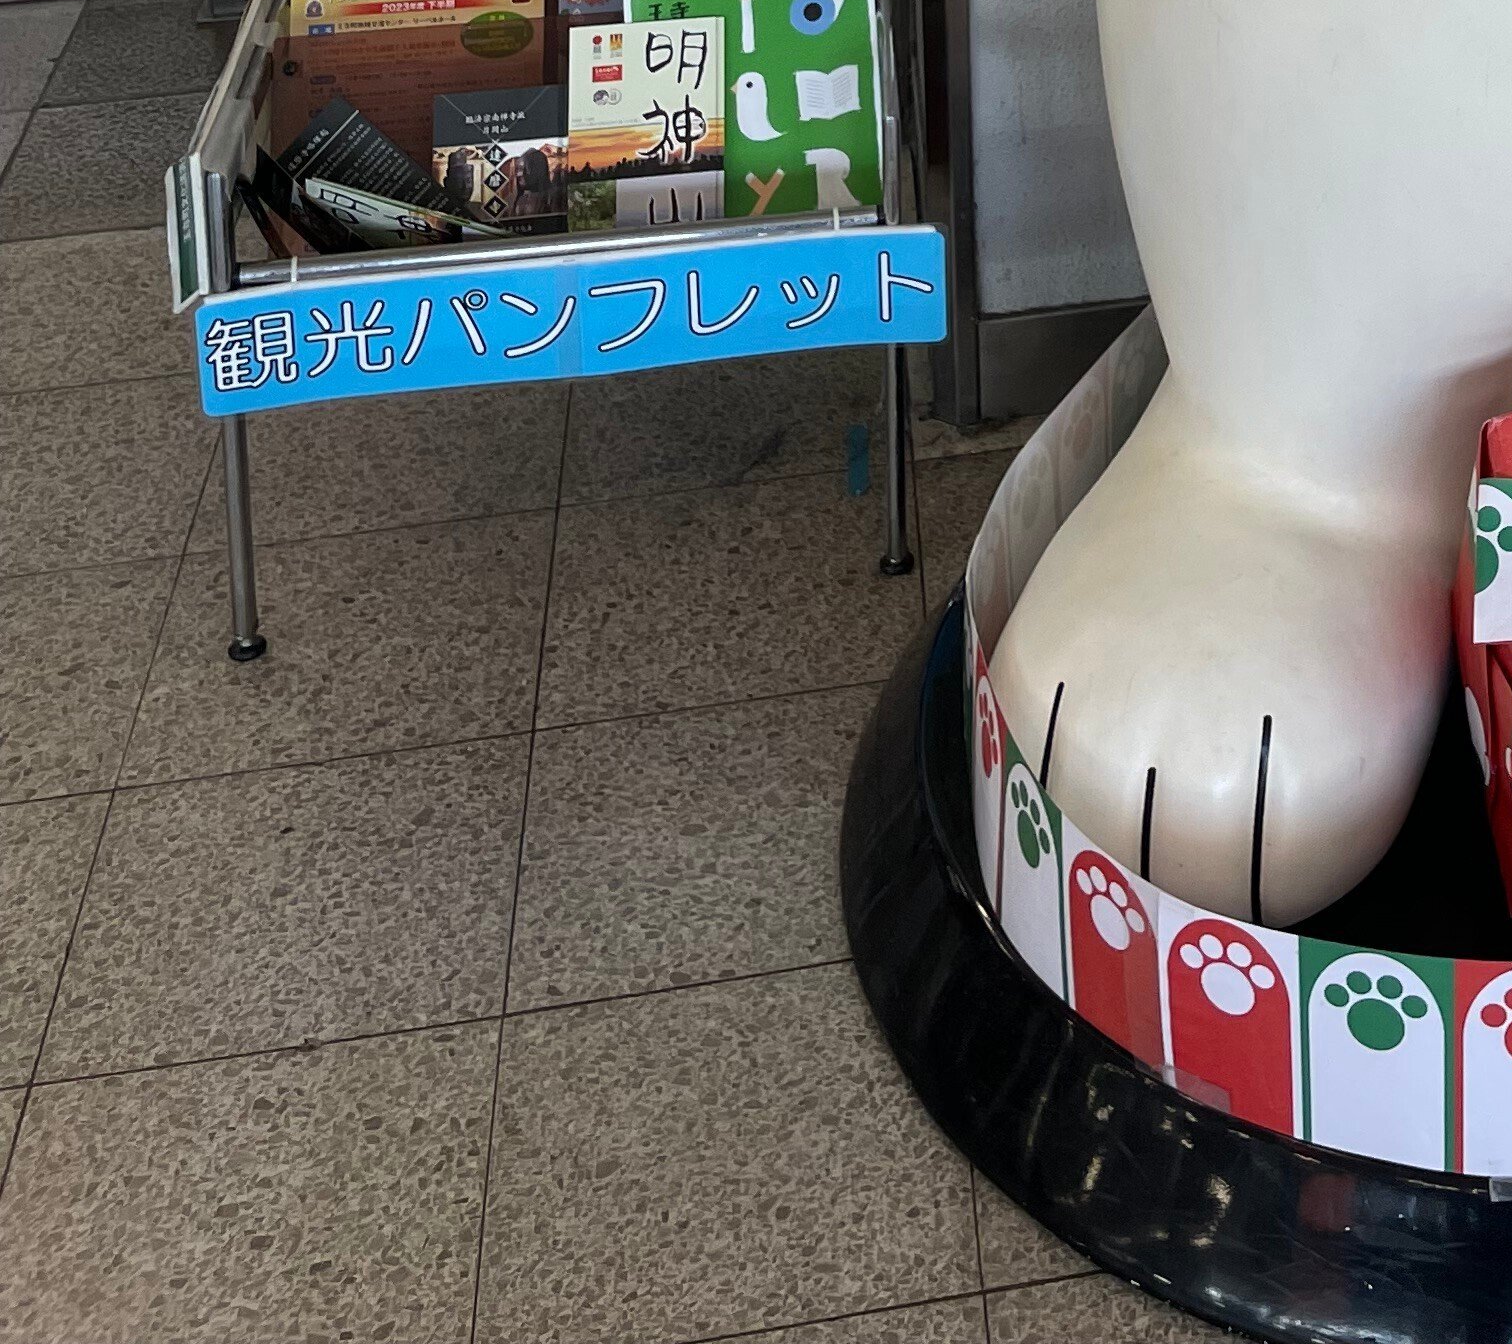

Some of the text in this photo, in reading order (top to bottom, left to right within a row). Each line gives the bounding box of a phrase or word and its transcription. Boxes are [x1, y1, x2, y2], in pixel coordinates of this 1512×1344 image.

[205, 252, 933, 392] 観光パンフレット
